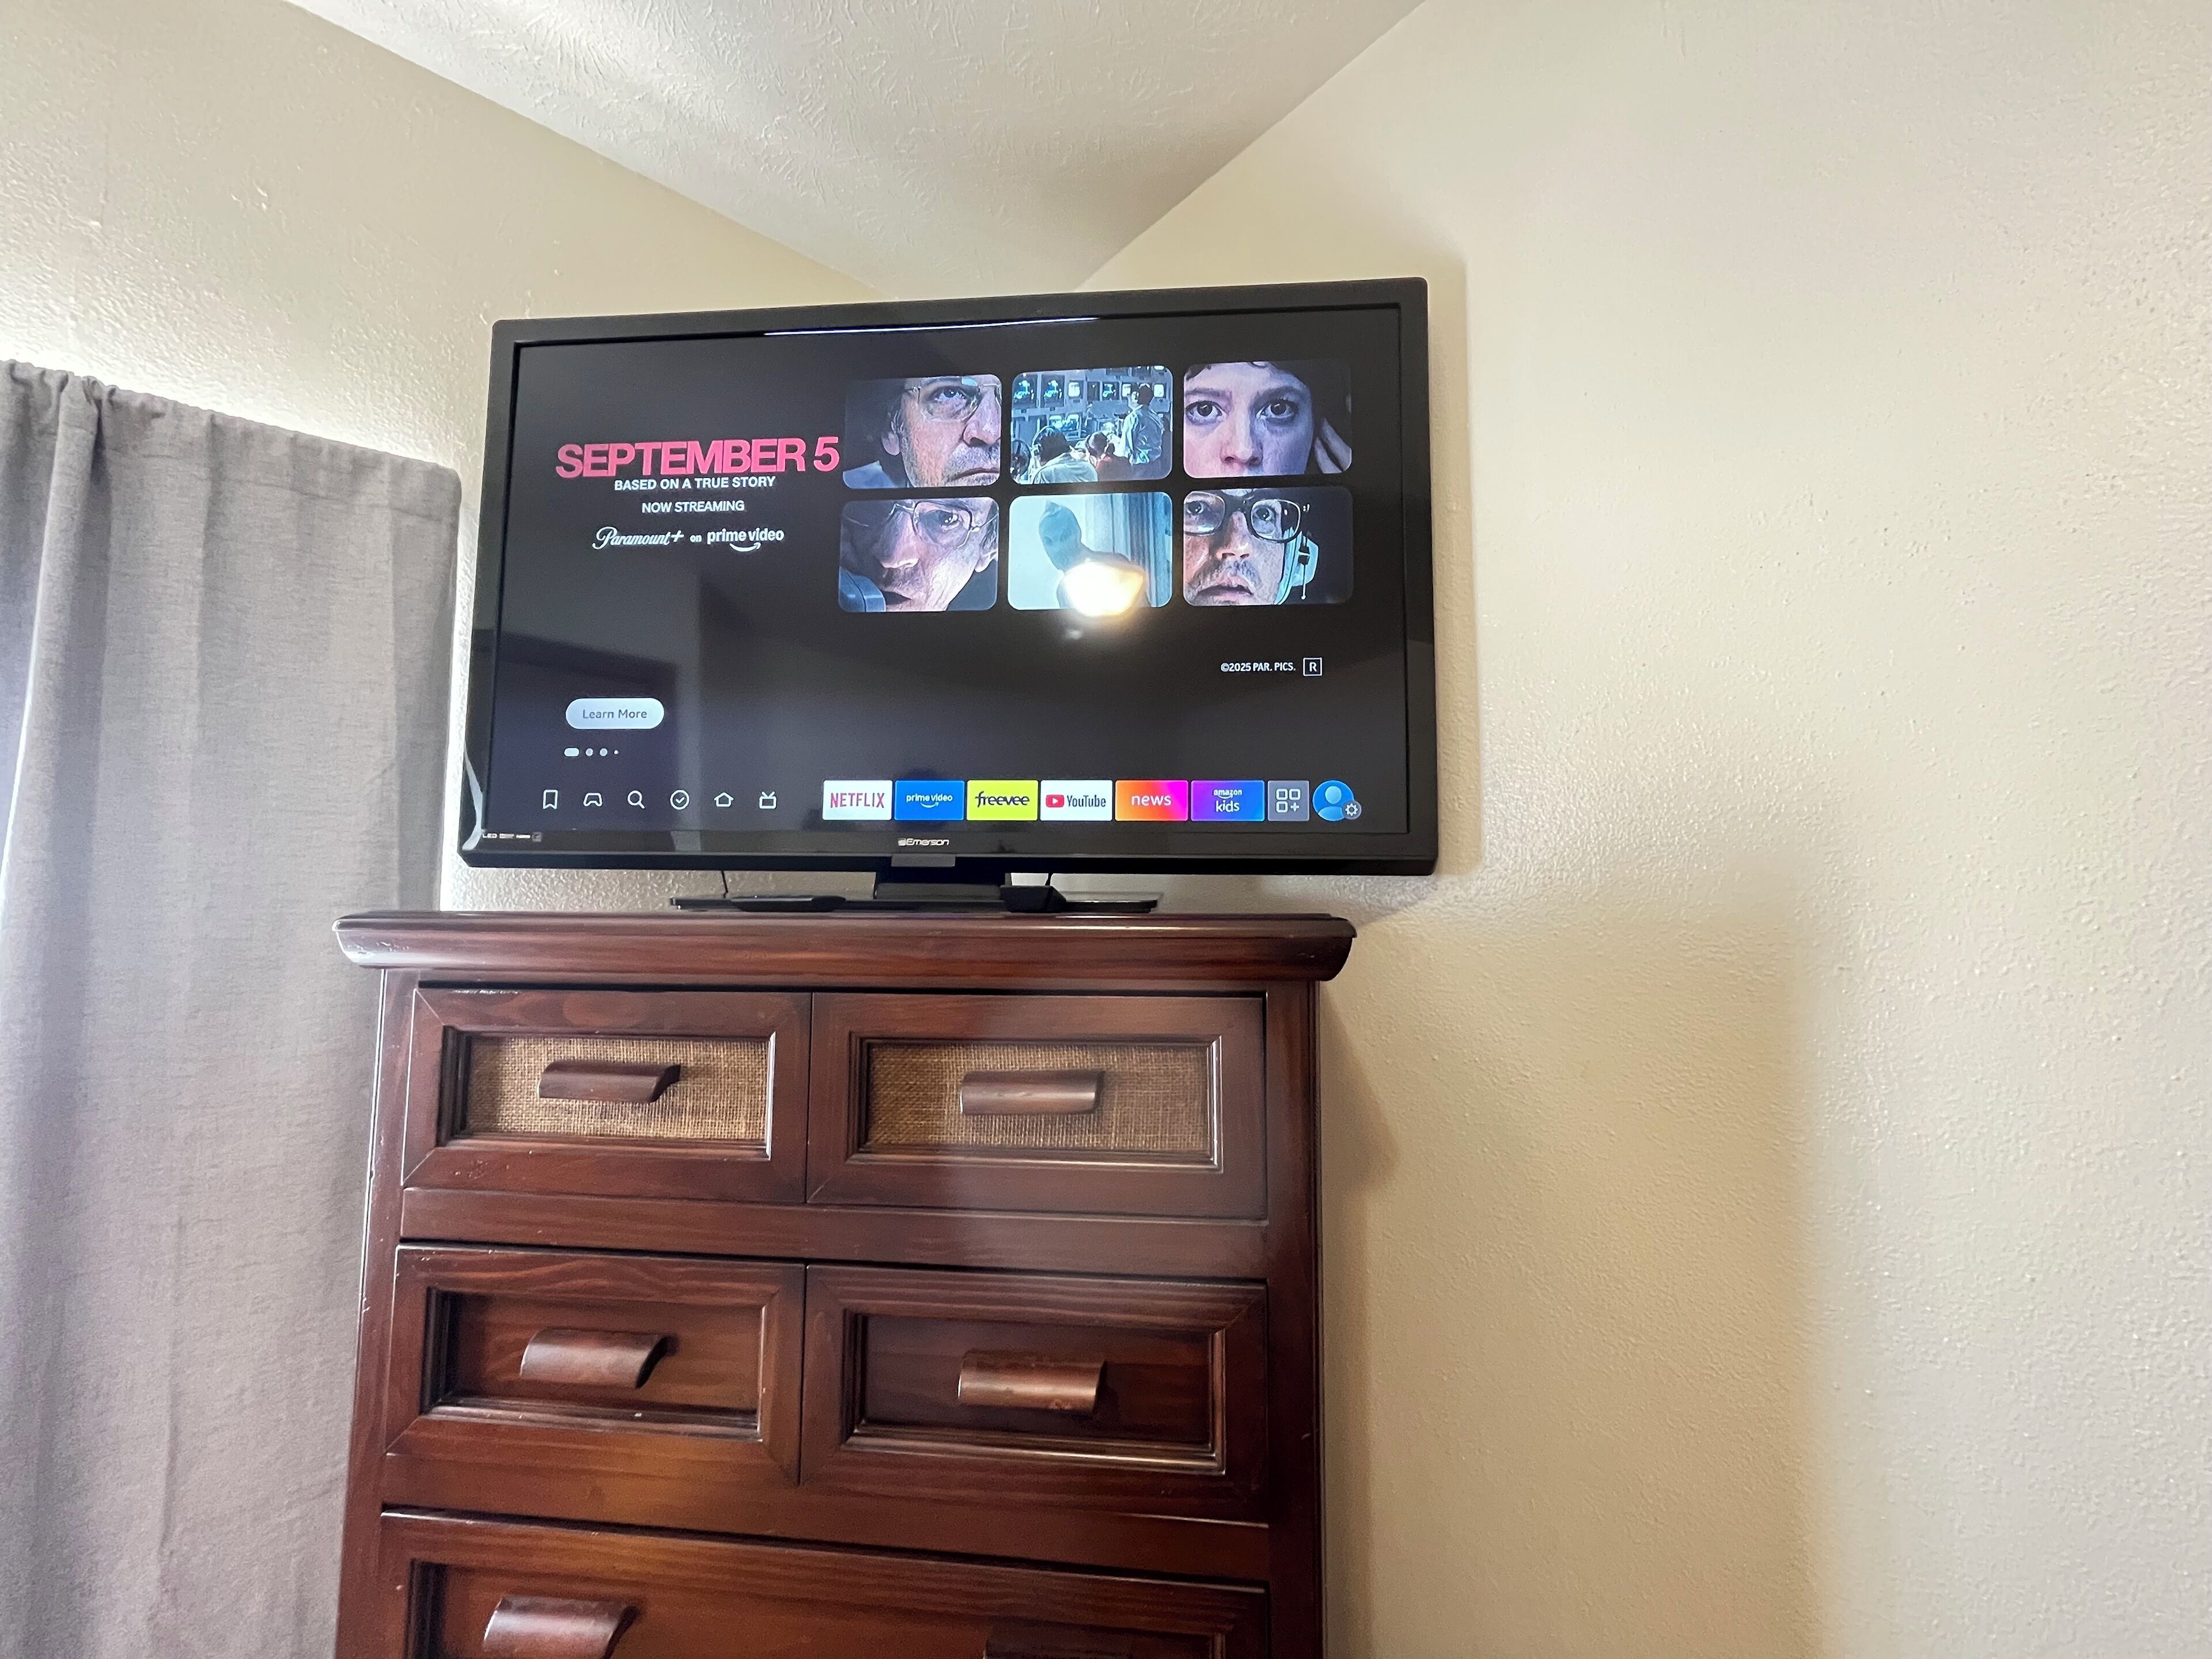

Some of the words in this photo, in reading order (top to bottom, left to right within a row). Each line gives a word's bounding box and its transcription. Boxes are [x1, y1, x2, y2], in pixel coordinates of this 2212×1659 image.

[556, 438, 806, 478] SEPTEMBER
[813, 436, 839, 471] 5
[614, 479, 657, 491] BASED
[660, 478, 680, 490] ON
[681, 478, 691, 489] A
[694, 478, 729, 489] TRUE
[732, 476, 776, 488] STORY
[642, 502, 672, 513] NOW
[674, 500, 745, 513] STREAMING
[592, 526, 684, 550] Paramount+
[690, 533, 702, 543] on
[707, 528, 747, 545] prime
[748, 527, 785, 541] video
[1252, 662, 1272, 672] PAR.
[1274, 662, 1296, 671] PICS.
[1309, 662, 1317, 672] R
[582, 709, 614, 718] Learn
[618, 709, 647, 718] More
[830, 792, 885, 808] NETFLIX
[906, 794, 930, 803] prime
[931, 793, 953, 802] video
[975, 790, 1030, 808] freevee
[1131, 794, 1172, 806] news
[1213, 789, 1243, 798] amazon
[1067, 794, 1106, 808] YouTube
[1215, 800, 1240, 813] kids
